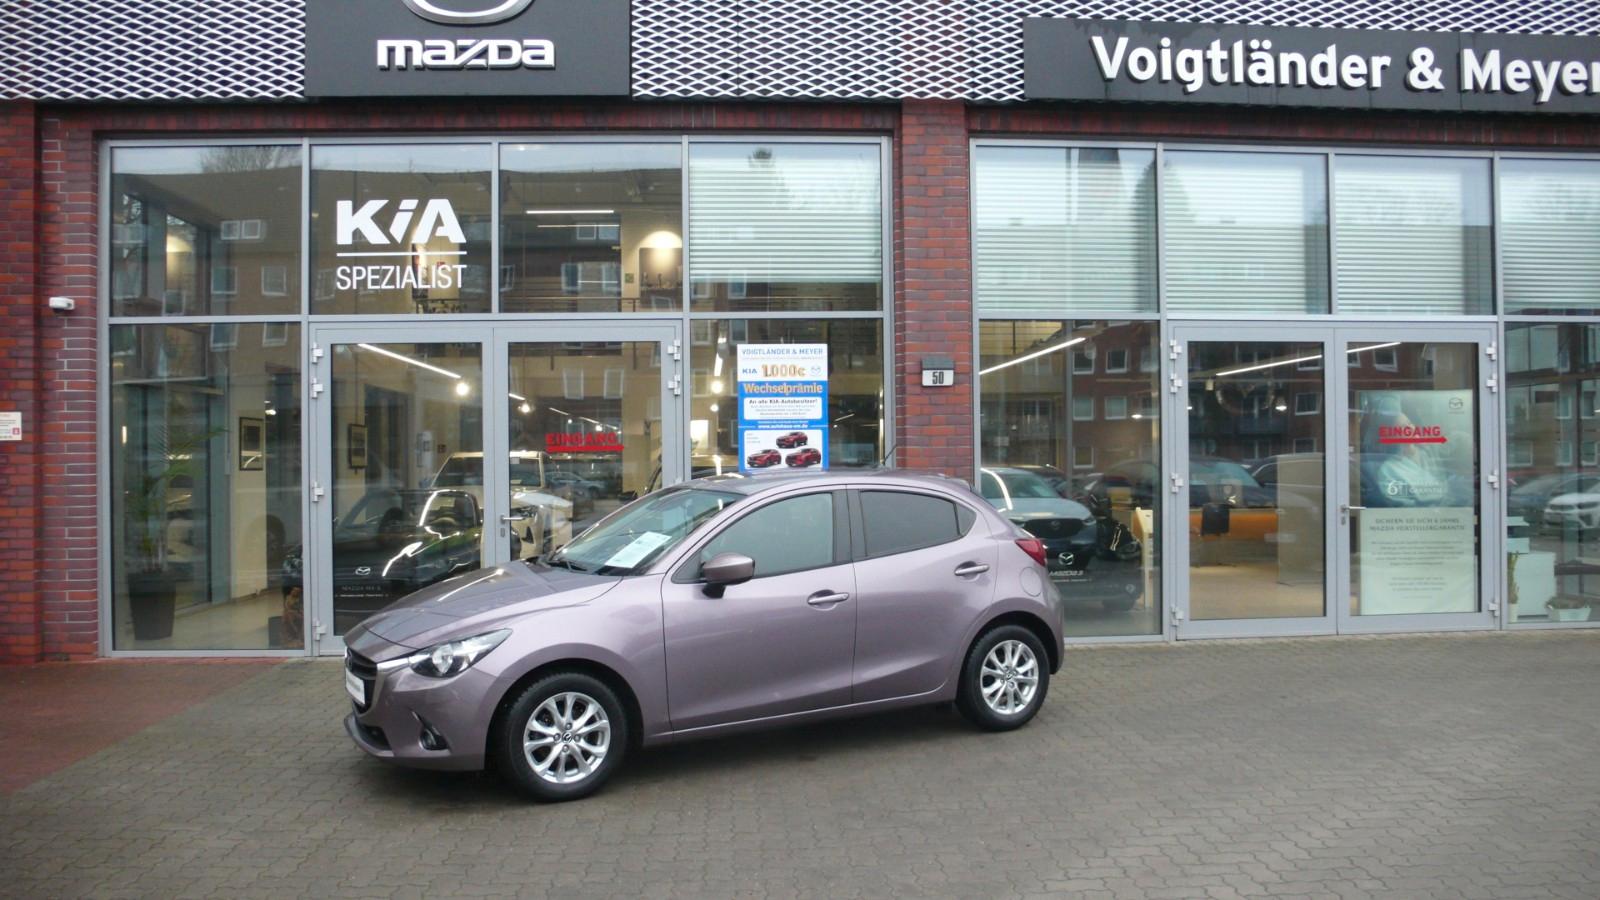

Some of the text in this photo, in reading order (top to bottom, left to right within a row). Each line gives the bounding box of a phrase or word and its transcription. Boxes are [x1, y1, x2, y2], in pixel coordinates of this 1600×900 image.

[1091, 36, 1391, 93] Voigtländer
[1405, 47, 1444, 91] &
[336, 264, 467, 290] SPEZIALIST
[932, 371, 945, 385] 50
[744, 383, 823, 395] Wechselprämie
[1379, 425, 1441, 437] EINGANG
[545, 432, 617, 445] EINGANG
